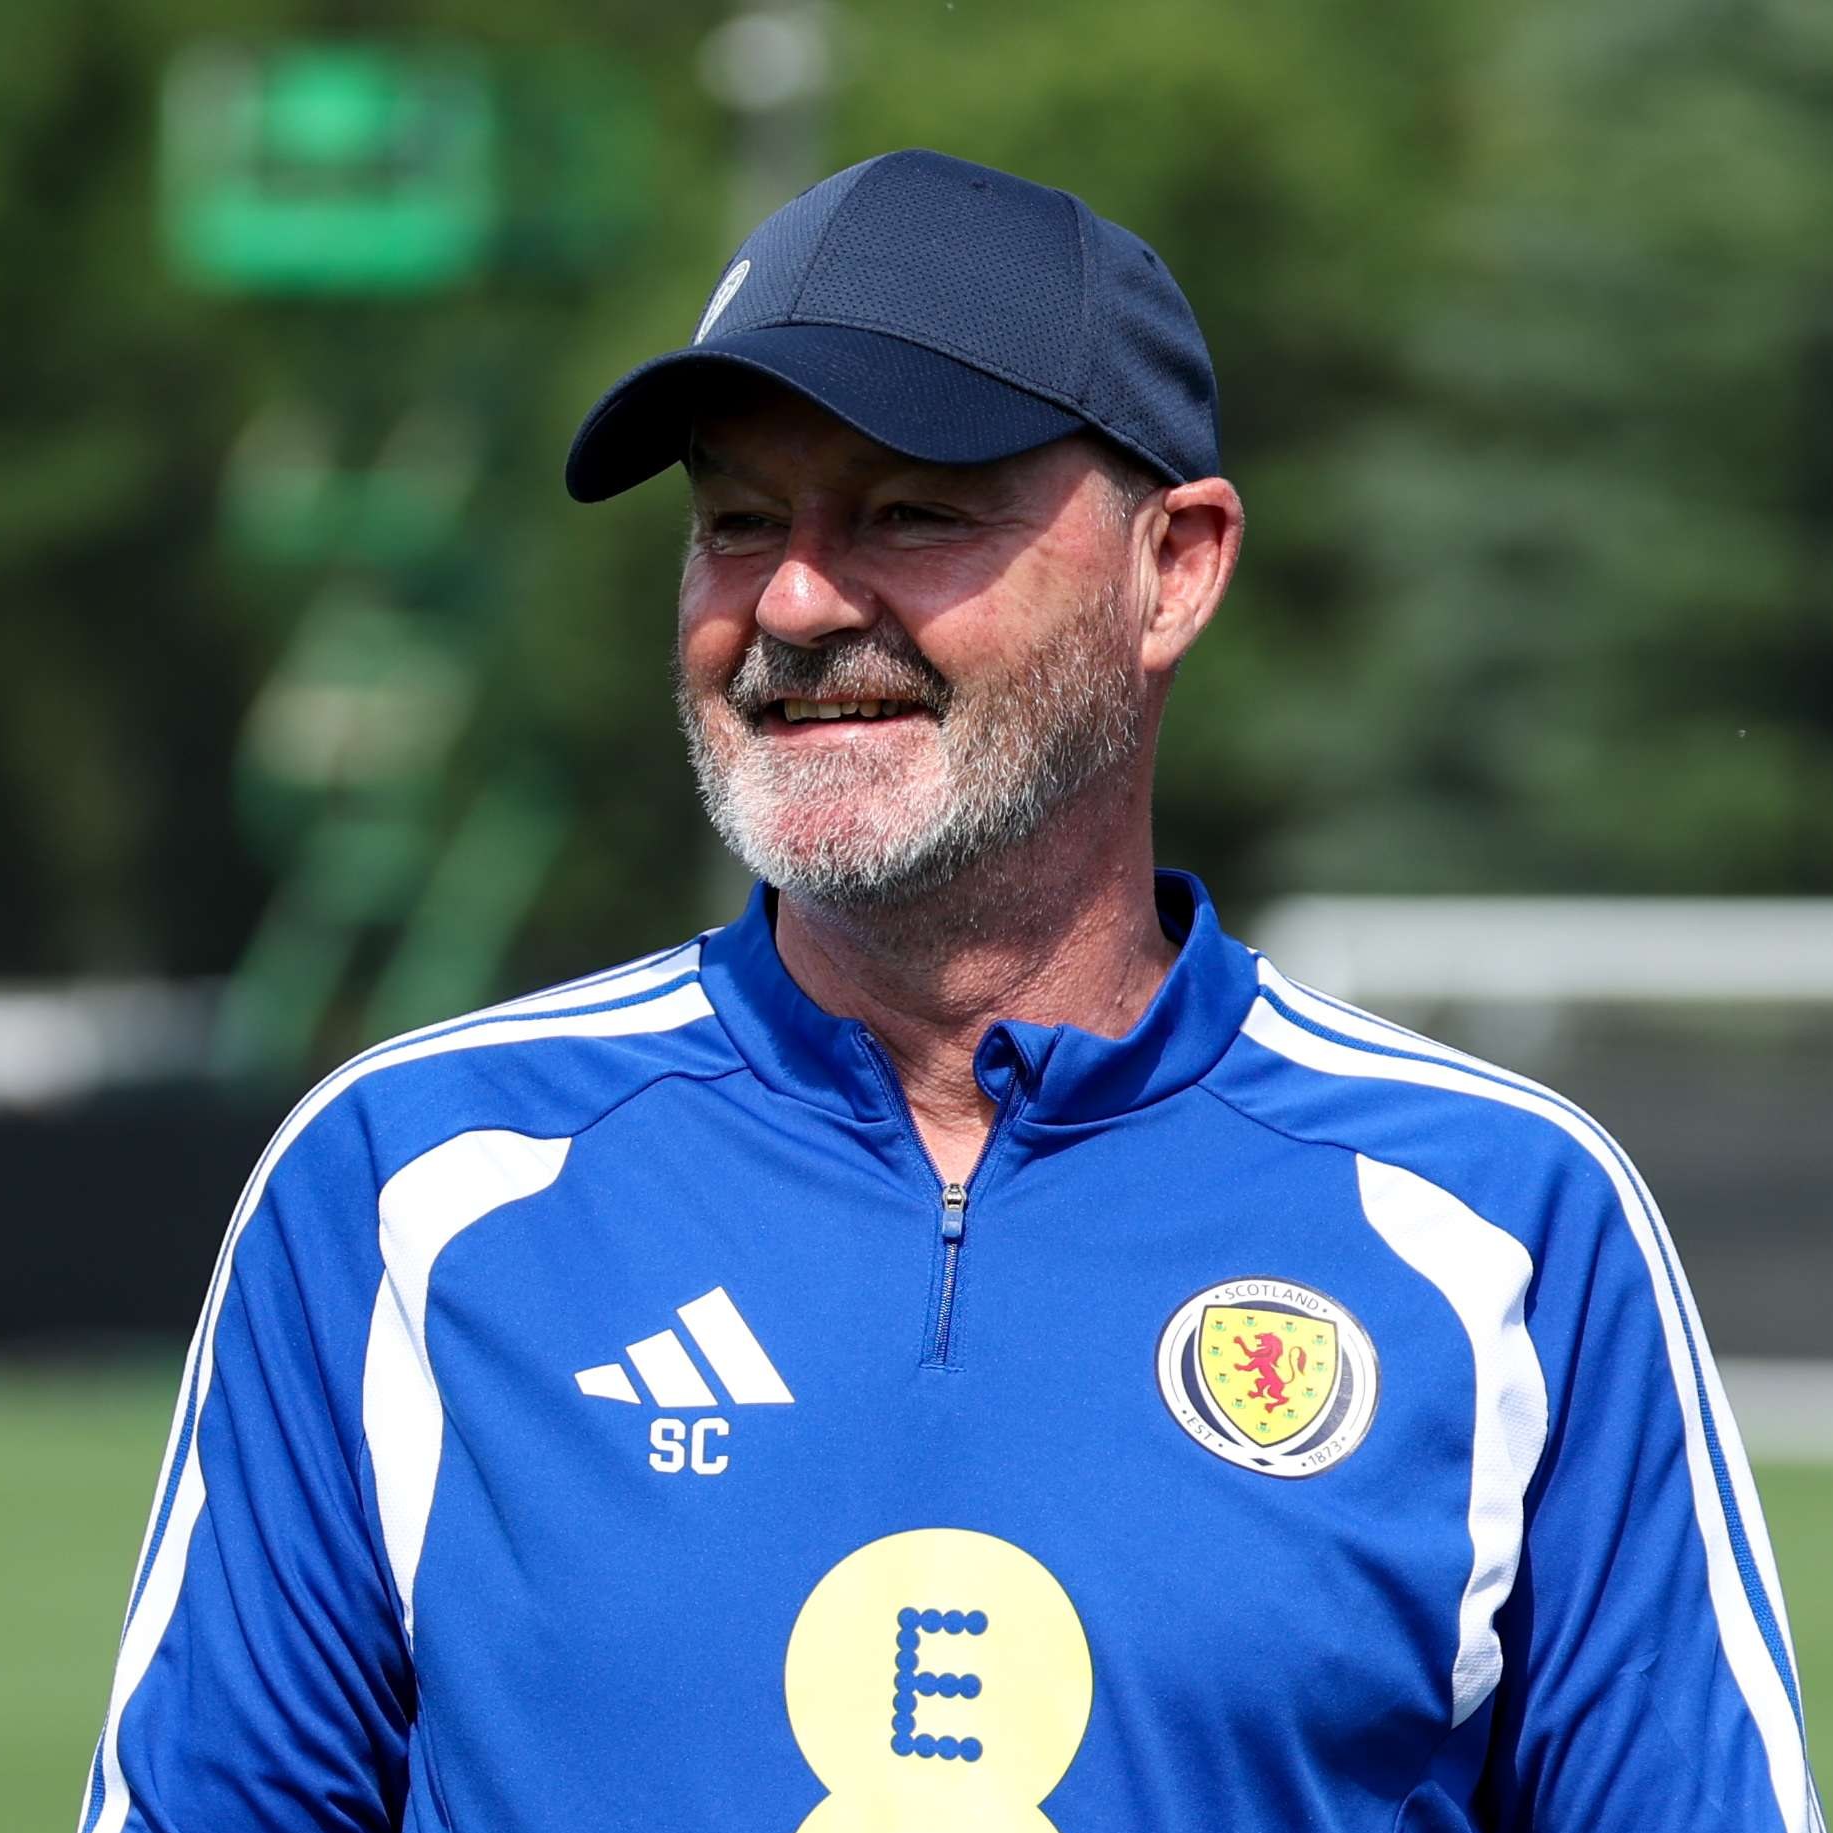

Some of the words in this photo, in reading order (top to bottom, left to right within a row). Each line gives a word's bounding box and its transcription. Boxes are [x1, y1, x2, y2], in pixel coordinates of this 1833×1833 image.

[1225, 1283, 1319, 1311] SCOTLAND
[1186, 1416, 1214, 1442] EST
[648, 1416, 730, 1476] SC
[1308, 1440, 1343, 1466] 1873
